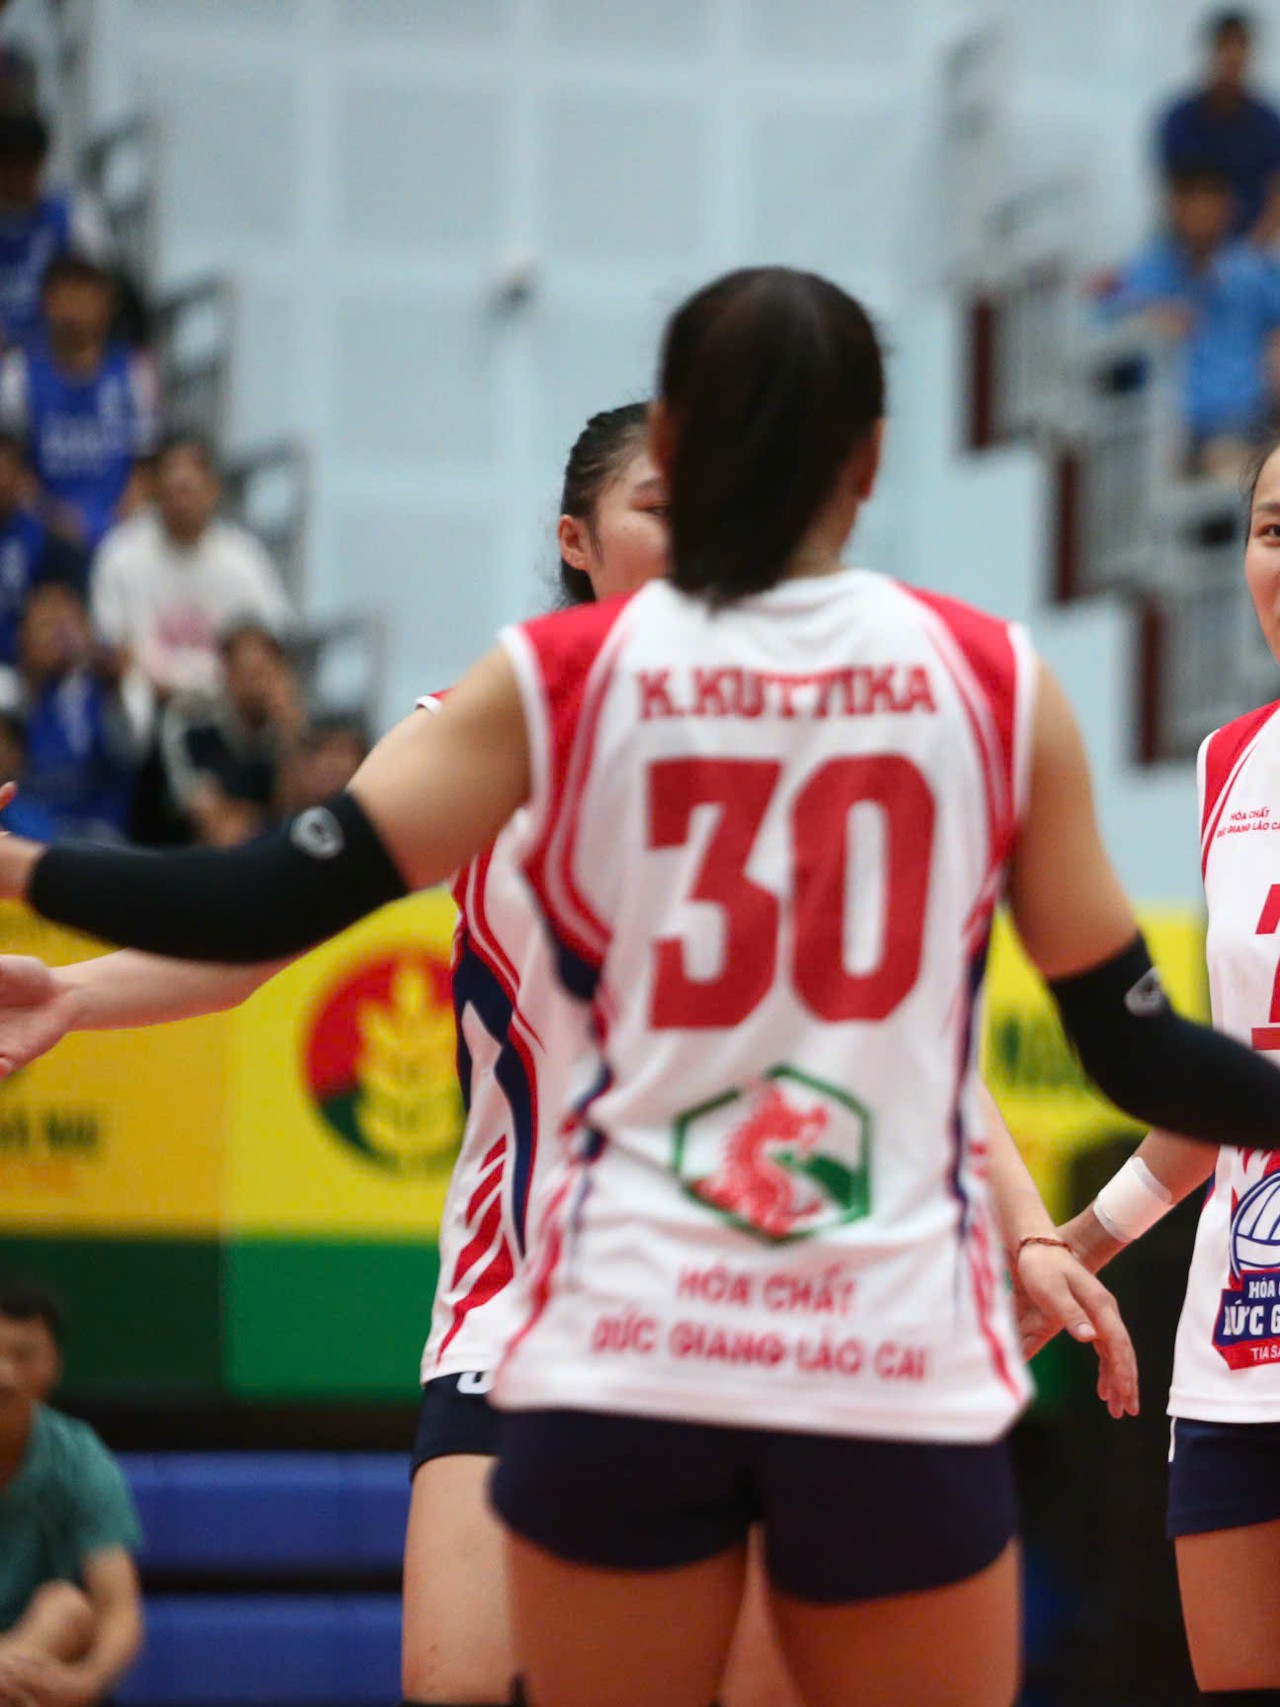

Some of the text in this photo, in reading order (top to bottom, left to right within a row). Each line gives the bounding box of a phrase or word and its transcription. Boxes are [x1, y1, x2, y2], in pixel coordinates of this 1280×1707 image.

[646, 752, 936, 1032] 30
[1248, 1277, 1275, 1298] HÓA
[667, 1319, 787, 1368] GIANG
[874, 1340, 929, 1382] CAI
[1251, 1347, 1269, 1360] TIA
